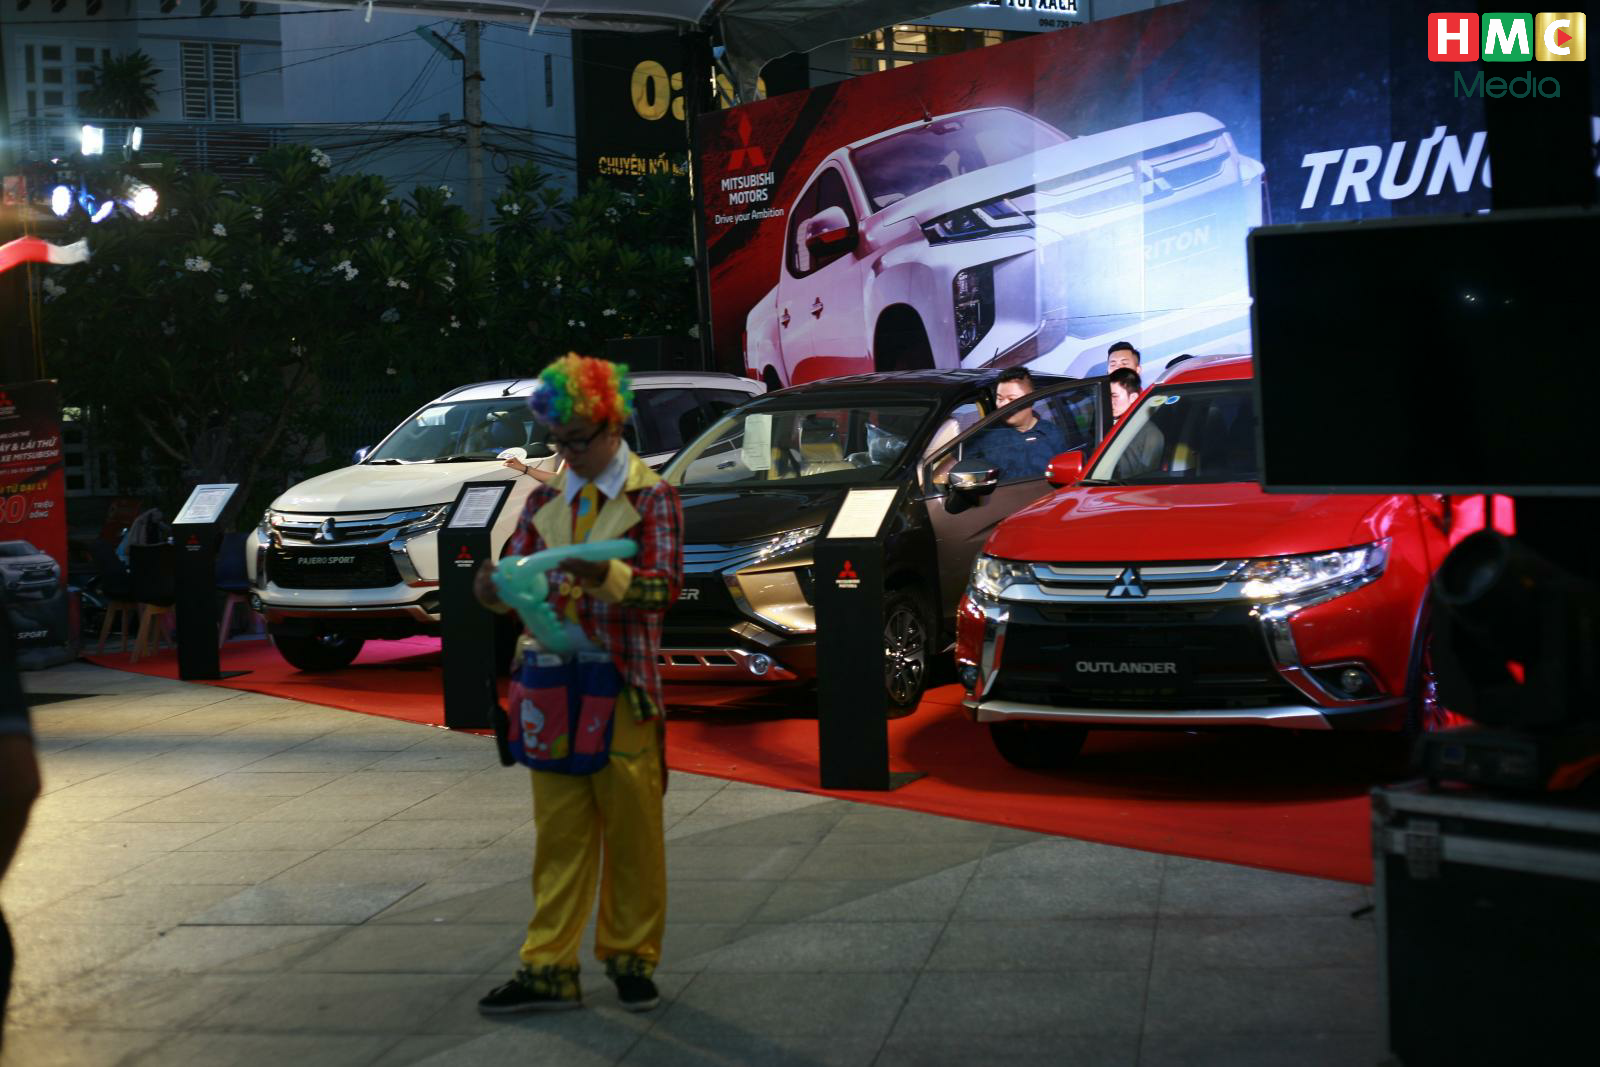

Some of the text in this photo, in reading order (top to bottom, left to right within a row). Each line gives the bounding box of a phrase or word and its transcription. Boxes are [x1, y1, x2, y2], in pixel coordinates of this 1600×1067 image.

[1300, 125, 1493, 210] TRƯN
[721, 171, 775, 191] MITSUBISHI
[729, 188, 768, 206] MOTORS
[715, 207, 784, 225] Drive your Ambition
[297, 555, 356, 566] PAJERO SPORT
[677, 587, 700, 601] ER
[1075, 660, 1178, 675] OUTLANDER
